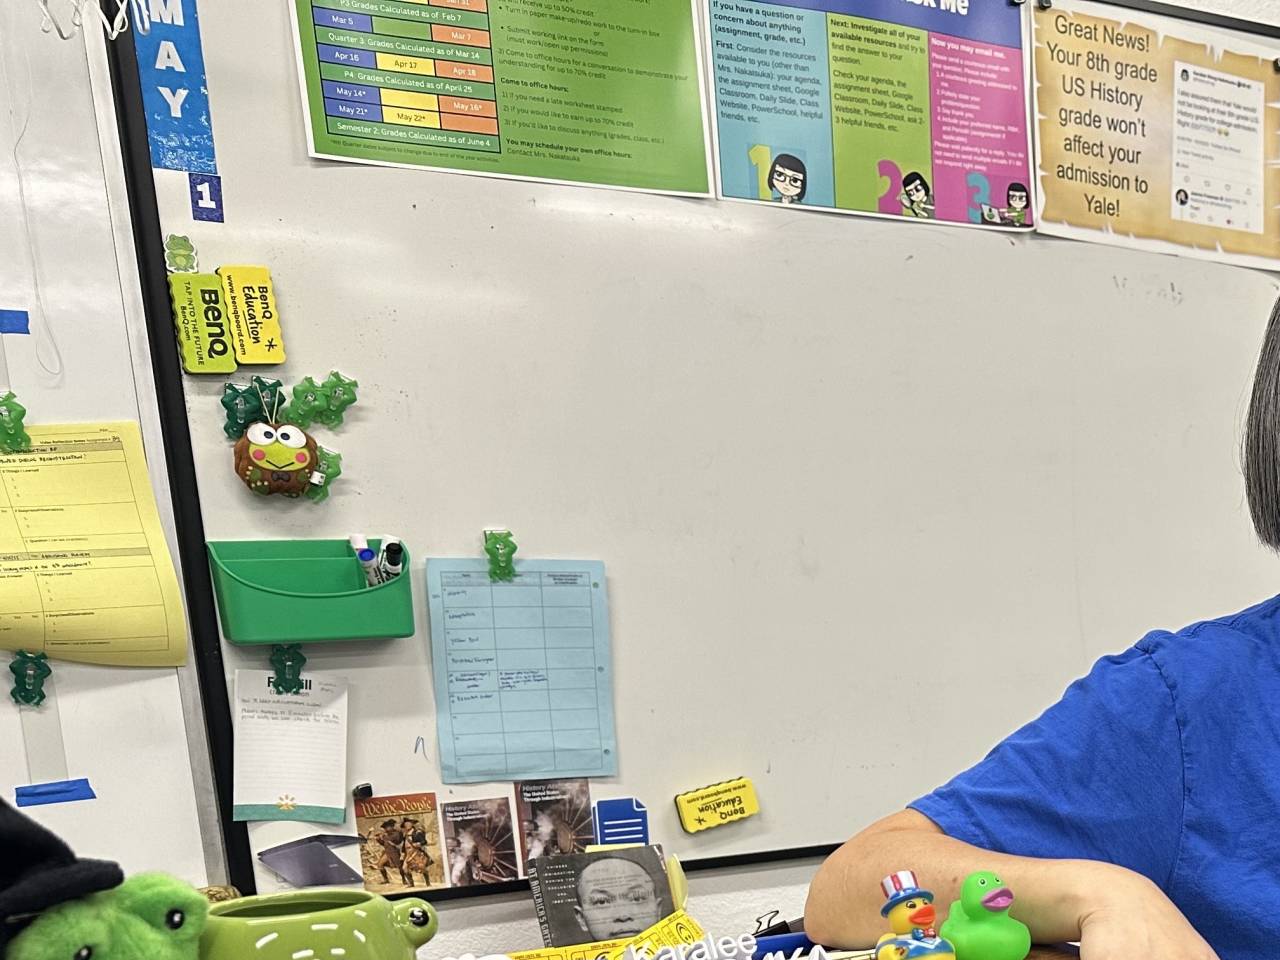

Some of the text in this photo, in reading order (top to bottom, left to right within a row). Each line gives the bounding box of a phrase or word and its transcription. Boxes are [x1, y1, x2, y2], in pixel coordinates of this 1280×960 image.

[720, 3, 733, 11] you
[736, 5, 754, 14] have
[762, 9, 794, 20] question
[714, 14, 801, 34] concern about anything
[714, 24, 762, 40] (assignment,
[764, 33, 788, 43] grade,
[830, 19, 850, 28] Next:
[850, 22, 888, 36] Investigate
[889, 28, 897, 36] all
[1055, 15, 1150, 53] Great News!
[831, 31, 896, 48] available resources
[149, 0, 189, 118] MAY
[334, 51, 348, 60] Apr
[394, 60, 408, 68] Apr
[1047, 41, 1158, 82] Your 8th grade
[336, 87, 352, 96] May
[358, 73, 384, 83] Grades
[386, 76, 425, 88] Calculated
[437, 82, 444, 90] of
[445, 83, 462, 92] April
[464, 85, 472, 93] 25
[1062, 74, 1143, 112] US History
[339, 104, 355, 114] May
[397, 112, 412, 122] May
[453, 101, 469, 110] May
[337, 122, 372, 133] Semester
[382, 128, 407, 138] Grades
[408, 131, 447, 142] Calculated
[448, 136, 457, 144] as
[458, 136, 466, 144] of
[467, 138, 484, 146] June
[1059, 108, 1146, 137] grade won't
[1064, 134, 1142, 165] affect your
[1057, 163, 1148, 194] admission to
[196, 182, 216, 209] 1
[1084, 193, 1120, 218] Yale!
[242, 286, 263, 344] Education
[258, 286, 273, 320] BenQ
[180, 306, 192, 341] BenQ.com
[184, 281, 204, 366] TAP INTO THE FUTURE
[200, 288, 228, 360] BenQ
[226, 275, 246, 356] www.benqboard.com
[720, 806, 746, 820] BenQ
[528, 868, 538, 878] AT
